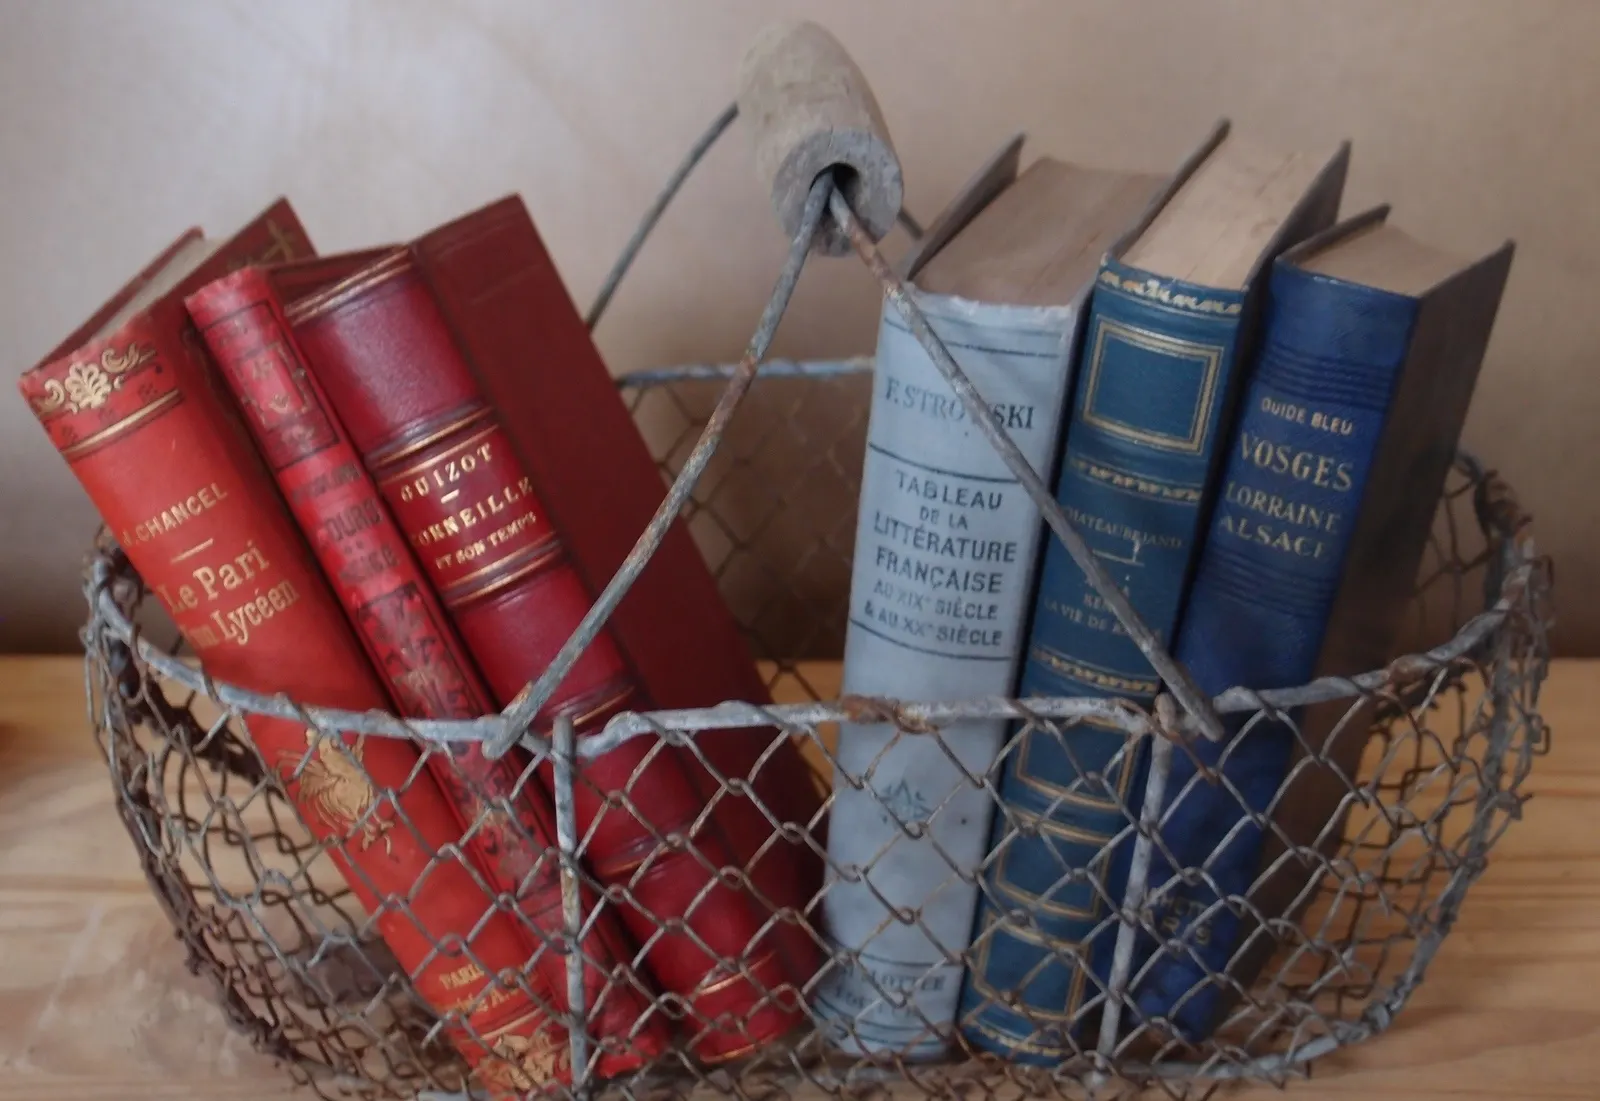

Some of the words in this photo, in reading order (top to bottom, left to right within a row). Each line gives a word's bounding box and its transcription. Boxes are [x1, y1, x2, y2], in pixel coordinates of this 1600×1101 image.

[1310, 411, 1354, 436] BLEU
[1239, 429, 1355, 492] VOSGES
[413, 476, 533, 546] ORNEILLE
[894, 467, 1004, 510] TABLEAU
[1224, 480, 1342, 534] LORRAINE
[873, 510, 1018, 563] LITTÉRATURE
[919, 505, 941, 525] DE
[948, 513, 969, 531] LA
[155, 582, 199, 614] Le
[192, 539, 270, 601] Pari
[456, 540, 486, 565] SON
[875, 545, 1004, 594] FRANÇAISE
[209, 579, 300, 646] Lycéen
[864, 600, 874, 618] &
[877, 607, 898, 628] AU
[935, 624, 1003, 647] SIÈCLE
[934, 597, 999, 621] SIÈCLE
